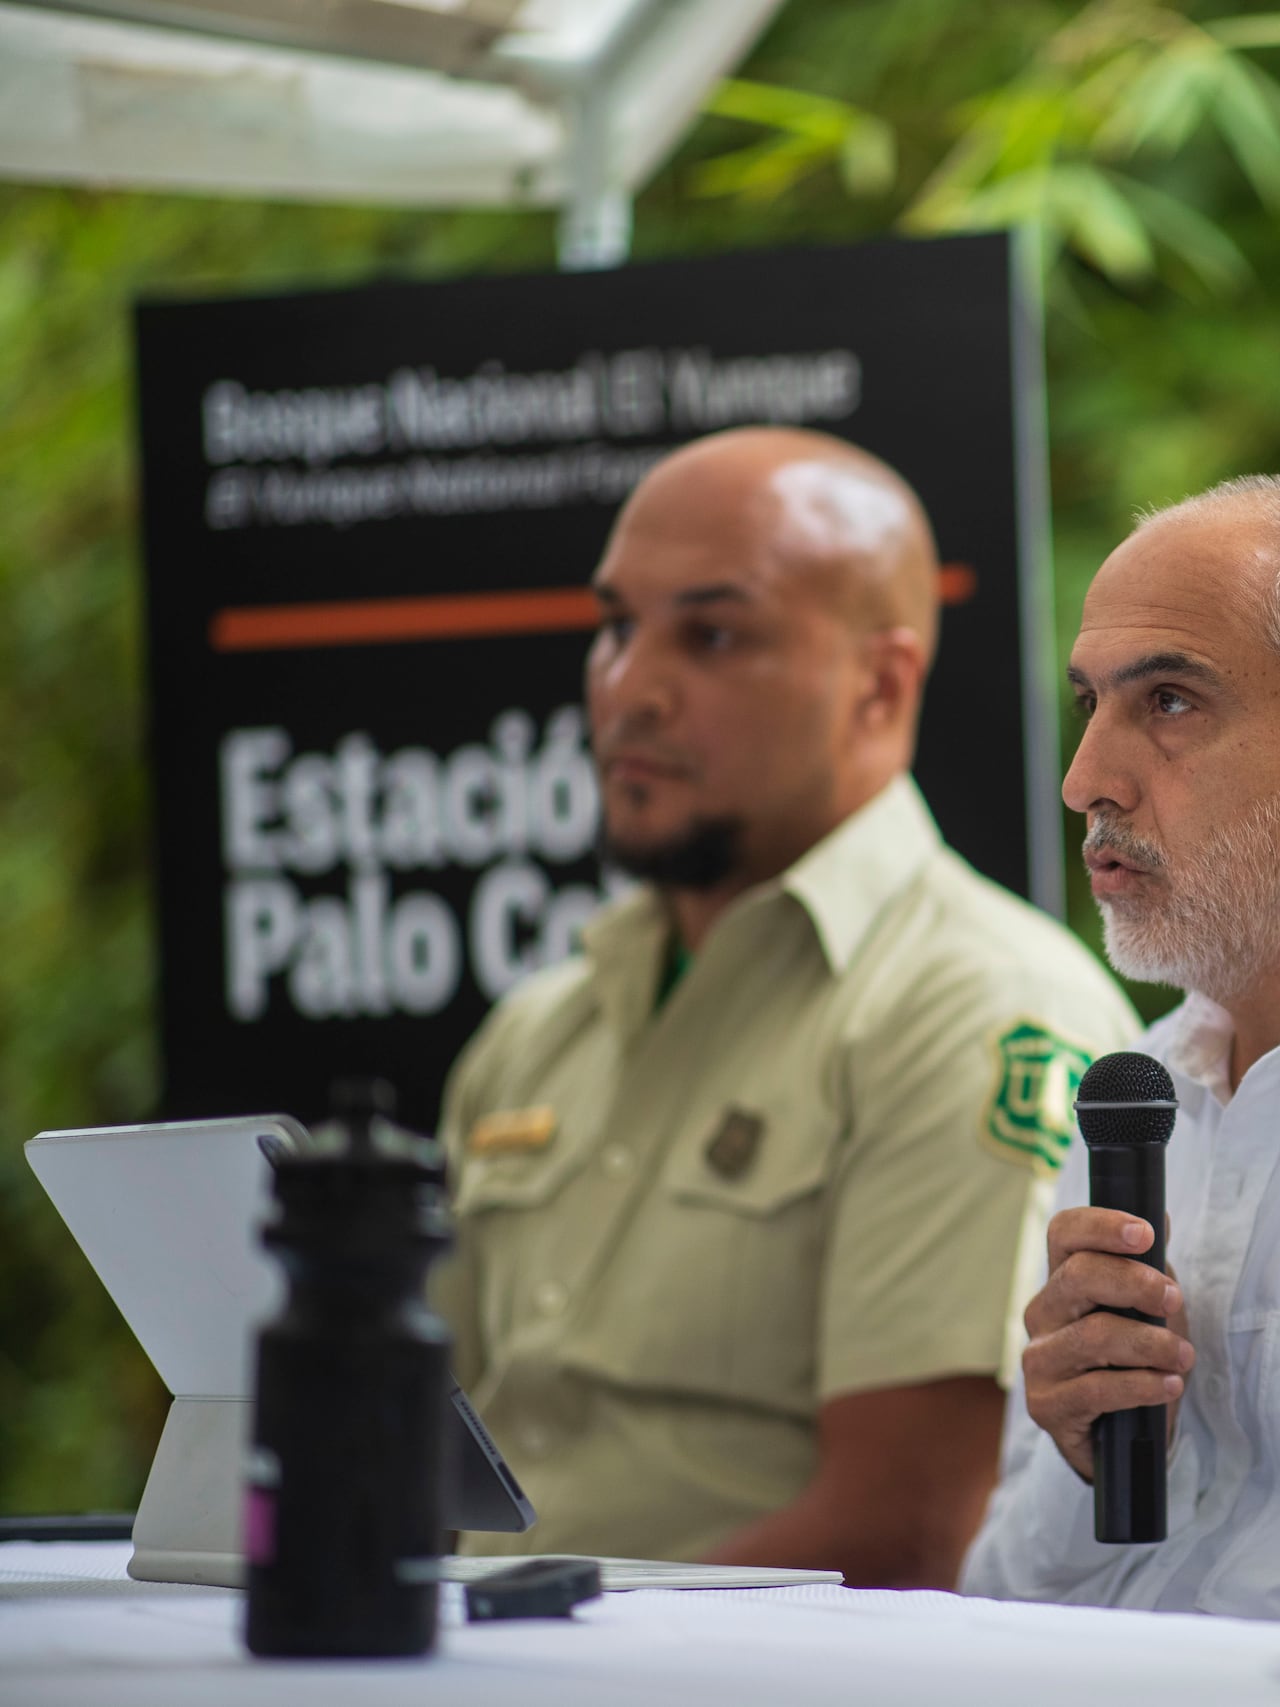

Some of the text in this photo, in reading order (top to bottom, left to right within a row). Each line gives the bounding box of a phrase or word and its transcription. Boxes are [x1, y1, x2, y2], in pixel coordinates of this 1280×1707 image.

[205, 379, 385, 466] Bosque
[389, 353, 604, 449] Nacional
[668, 347, 861, 426] Yunque
[225, 861, 640, 1021] Palo Co
